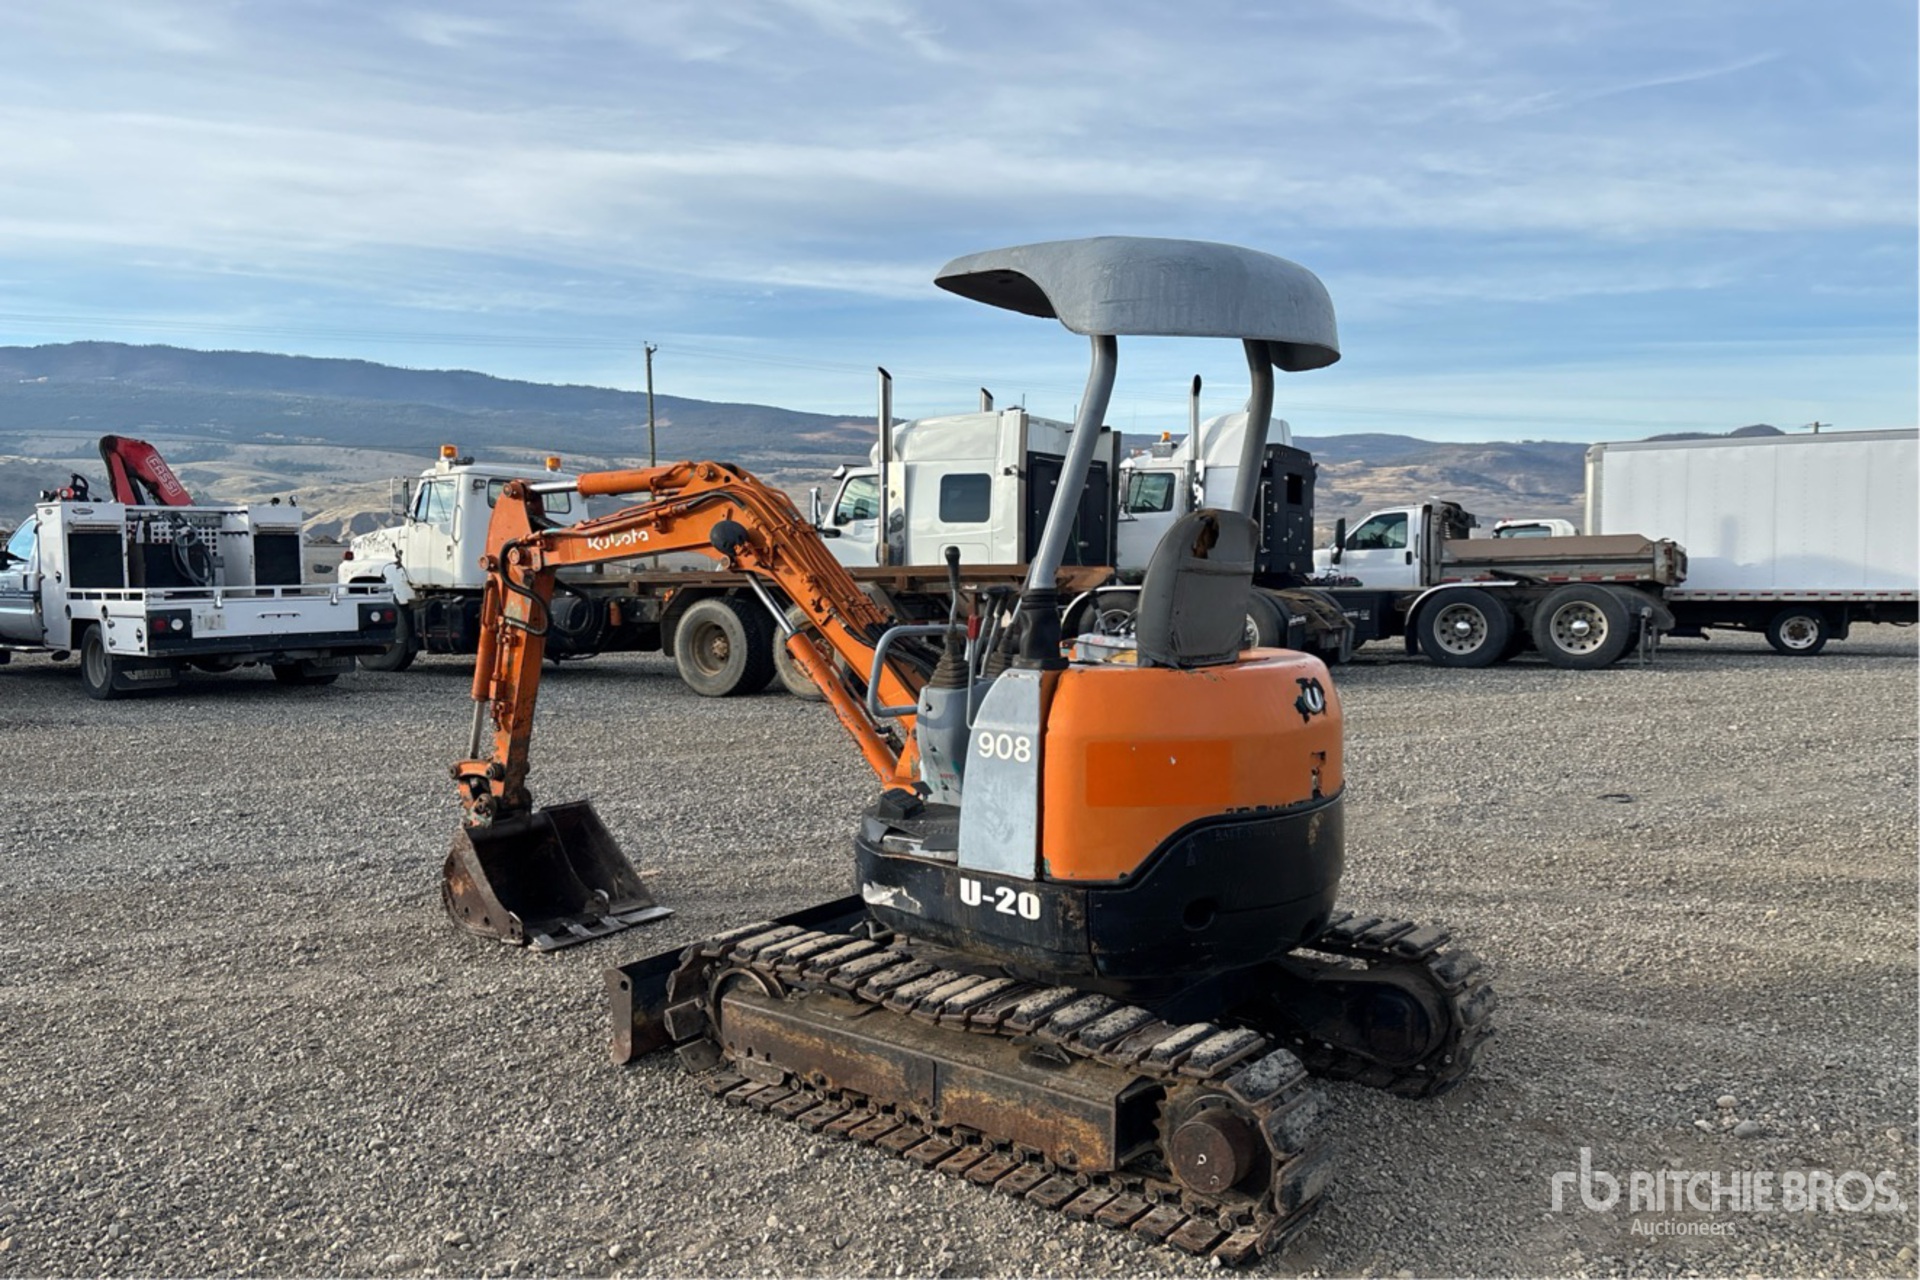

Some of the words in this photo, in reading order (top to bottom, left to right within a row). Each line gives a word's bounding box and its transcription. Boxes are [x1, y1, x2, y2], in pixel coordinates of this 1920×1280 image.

[148, 457, 178, 495] FASSI
[587, 529, 648, 551] Kubota
[978, 732, 1031, 762] 908
[960, 878, 1041, 920] U-20
